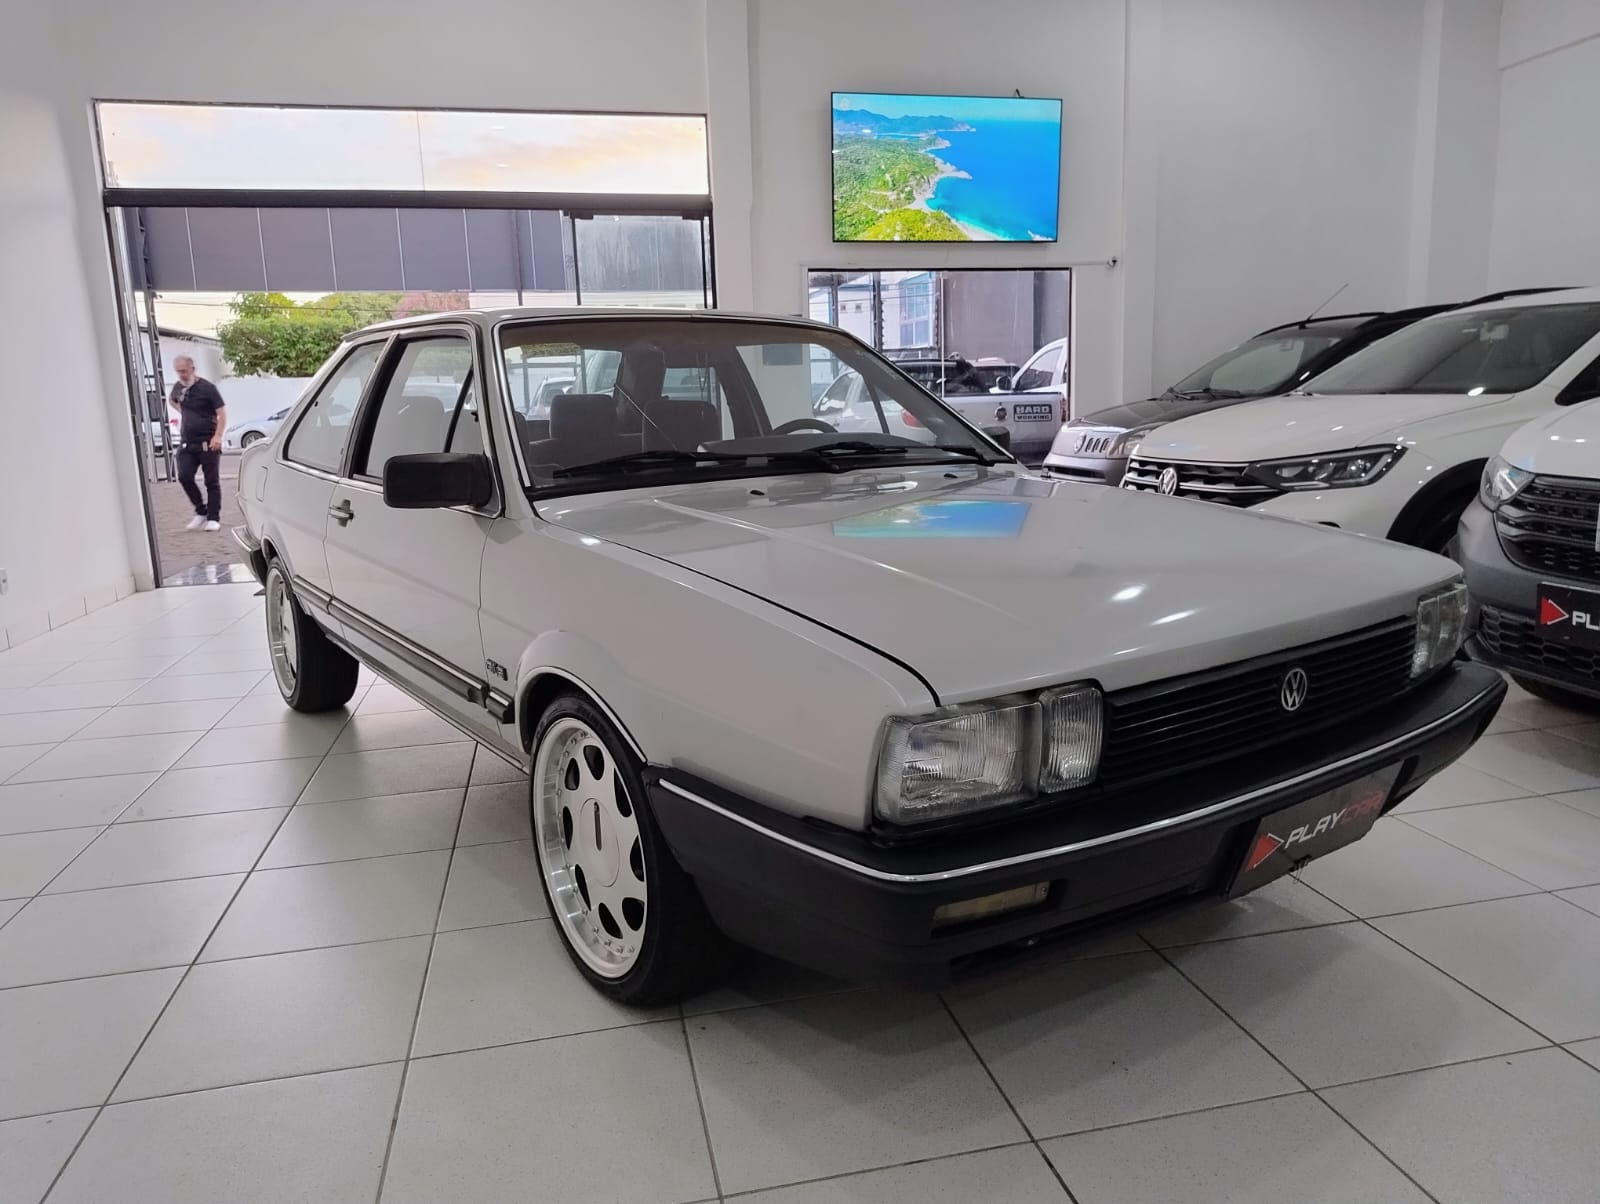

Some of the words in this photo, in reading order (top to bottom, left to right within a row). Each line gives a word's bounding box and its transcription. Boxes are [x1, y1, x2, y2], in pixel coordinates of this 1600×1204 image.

[1016, 405, 1050, 414] HARD
[1282, 669, 1307, 710] VW
[1284, 790, 1386, 849] PLAYCAR
